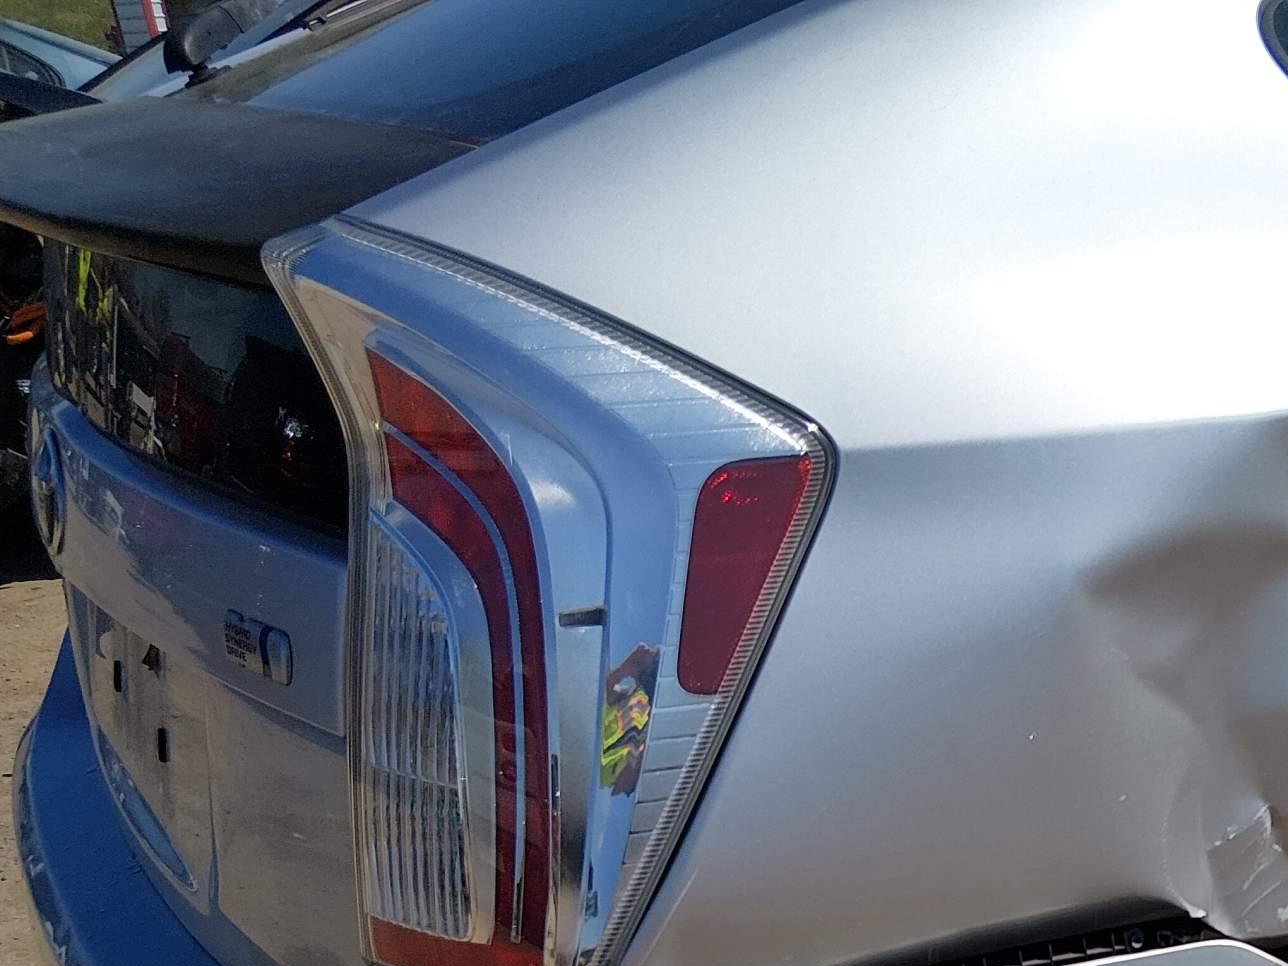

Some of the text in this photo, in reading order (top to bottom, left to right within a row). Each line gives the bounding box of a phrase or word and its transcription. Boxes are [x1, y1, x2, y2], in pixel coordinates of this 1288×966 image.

[223, 622, 251, 641] HYBRID
[224, 632, 257, 656] SYNERGY
[225, 644, 248, 663] DRIVE
